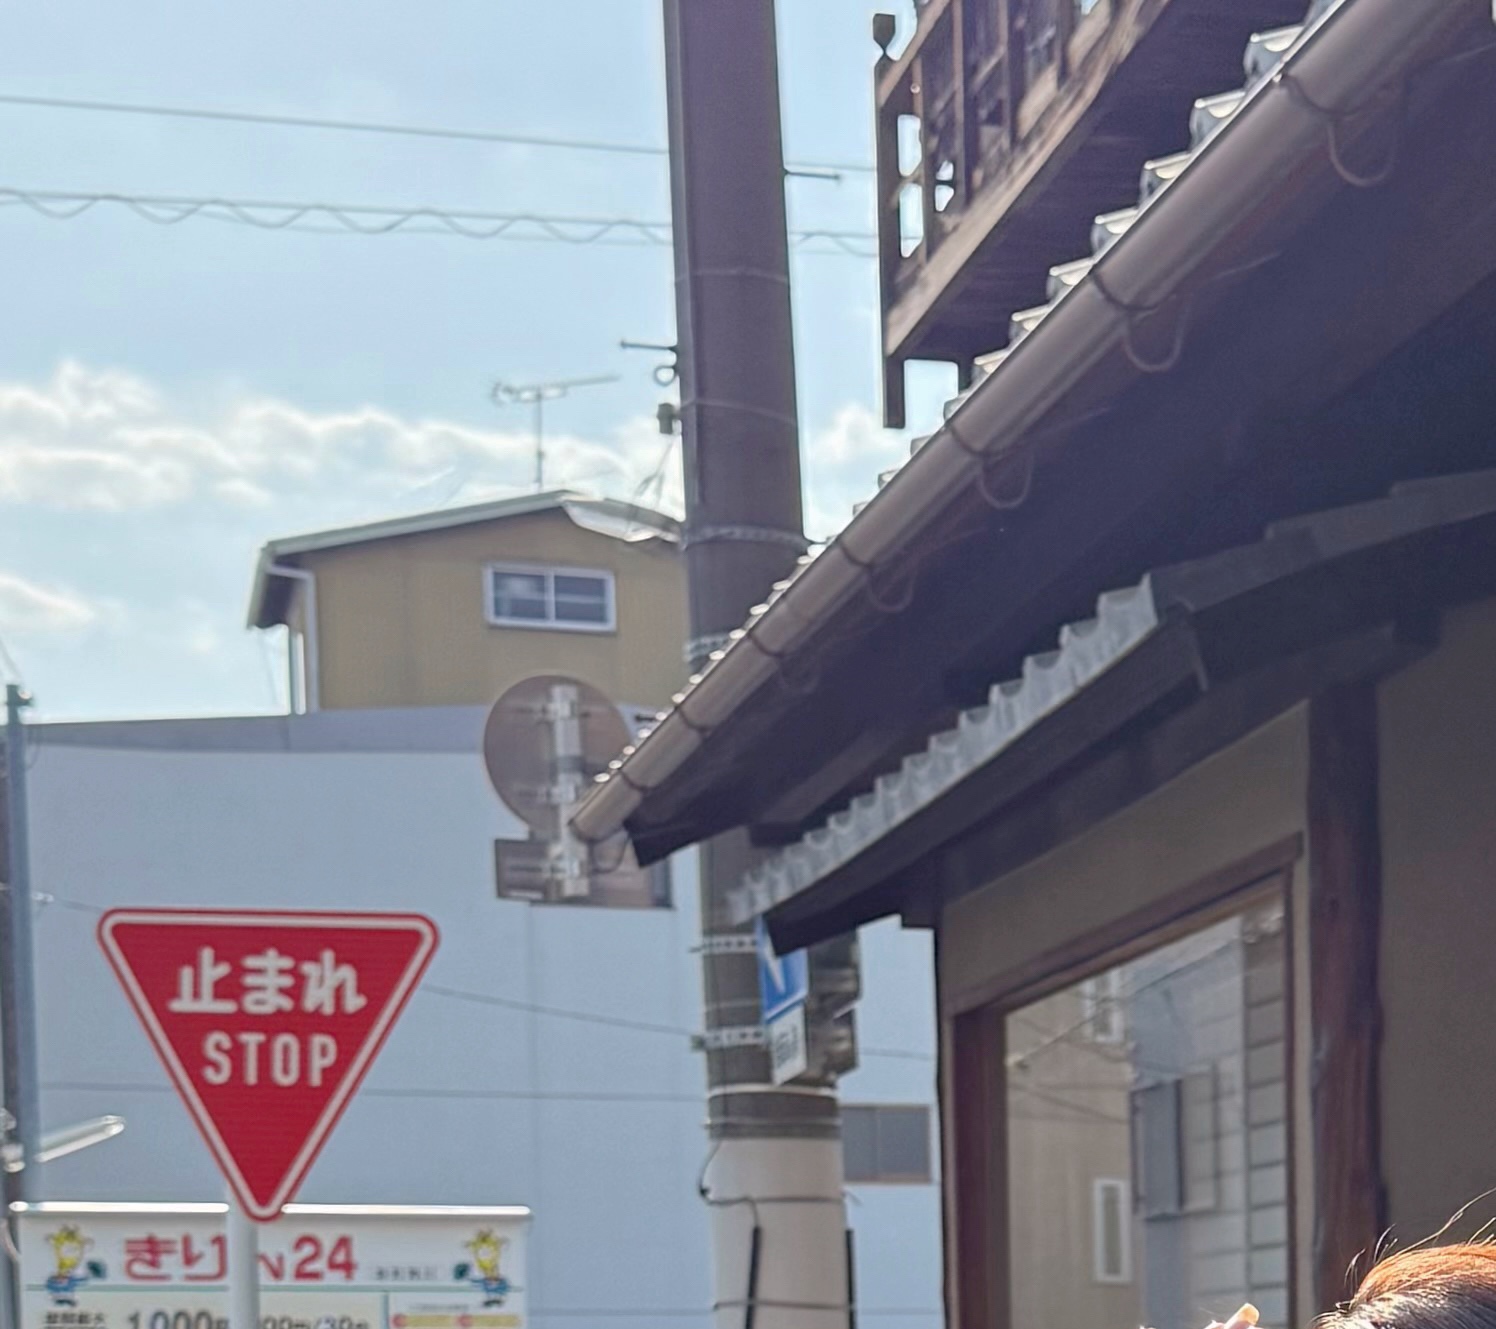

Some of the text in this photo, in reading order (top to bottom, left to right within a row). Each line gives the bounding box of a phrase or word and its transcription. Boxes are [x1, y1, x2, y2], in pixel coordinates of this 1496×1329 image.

[167, 946, 367, 1016] 止まれ
[203, 1030, 338, 1087] STOP
